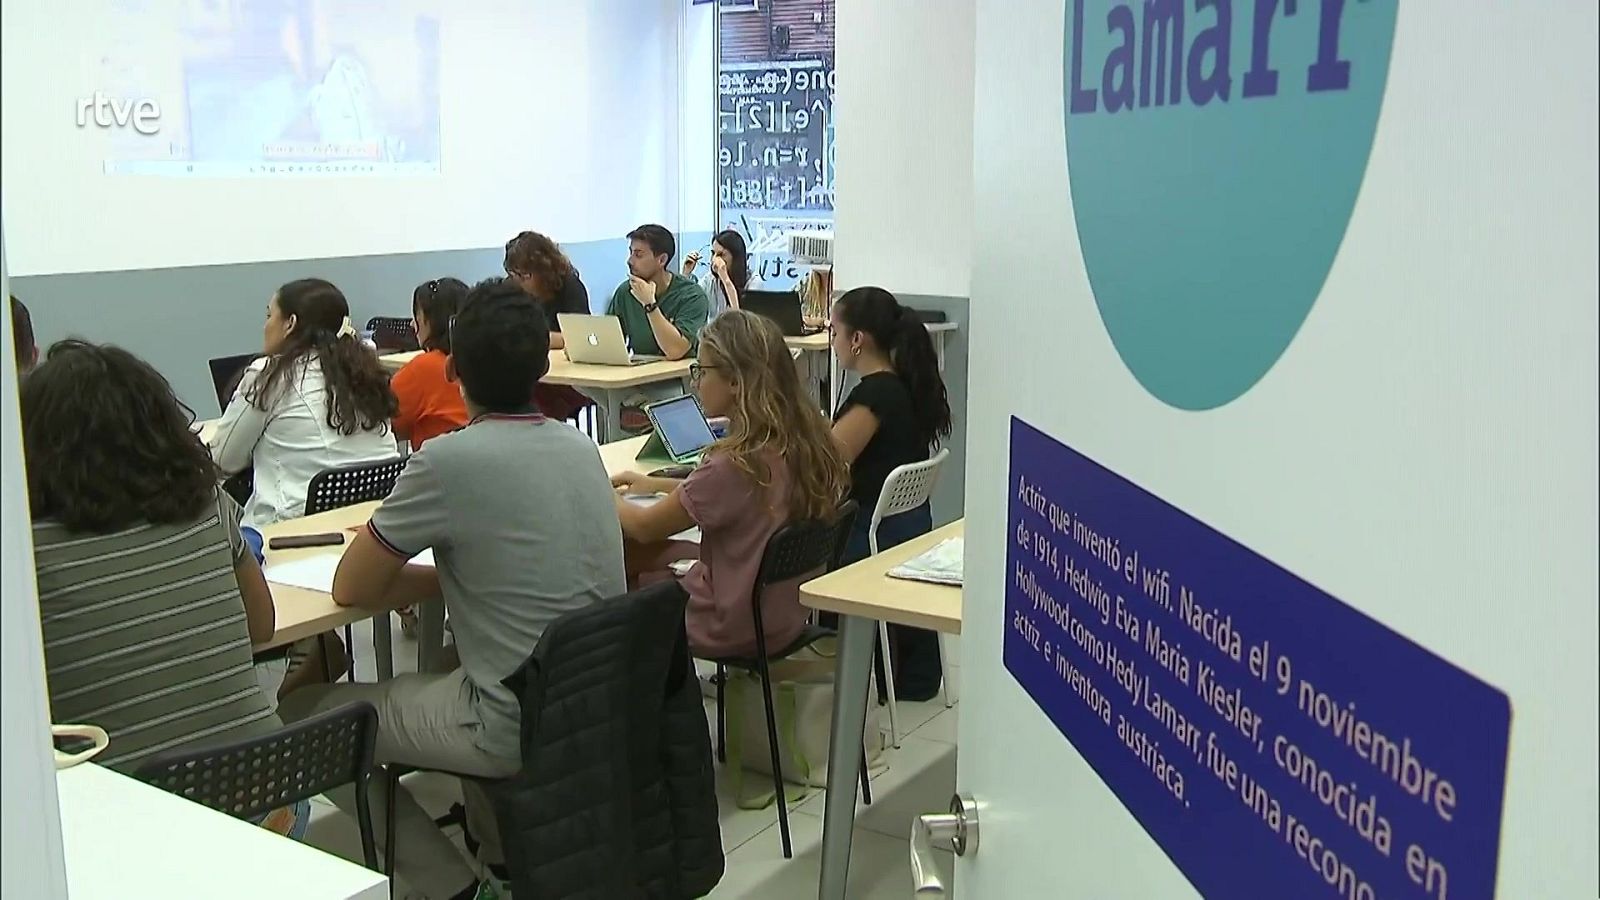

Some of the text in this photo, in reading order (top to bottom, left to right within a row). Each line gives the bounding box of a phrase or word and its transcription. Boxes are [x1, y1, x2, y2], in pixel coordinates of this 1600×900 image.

[1070, 0, 1370, 114] Lamarr
[1014, 610, 1040, 652] actriz
[1044, 641, 1051, 662] e
[1055, 645, 1111, 727] inventora
[1016, 560, 1070, 631] Hollywood
[1071, 621, 1104, 665] como
[1106, 641, 1142, 706] Hedy
[1144, 676, 1202, 764] Lamarr,
[1207, 732, 1237, 790] fue
[1241, 773, 1281, 833] una
[1017, 519, 1029, 550] de
[1034, 532, 1061, 580] 1914,
[1064, 554, 1110, 625] Hedwig
[1115, 595, 1139, 642] Eva
[1197, 661, 1264, 753] Kiesler,
[1274, 735, 1393, 857] conocida
[1406, 844, 1448, 900] en
[1018, 475, 1456, 821] Actriz que inventó el wifi. Nacida el 9 noviembre
